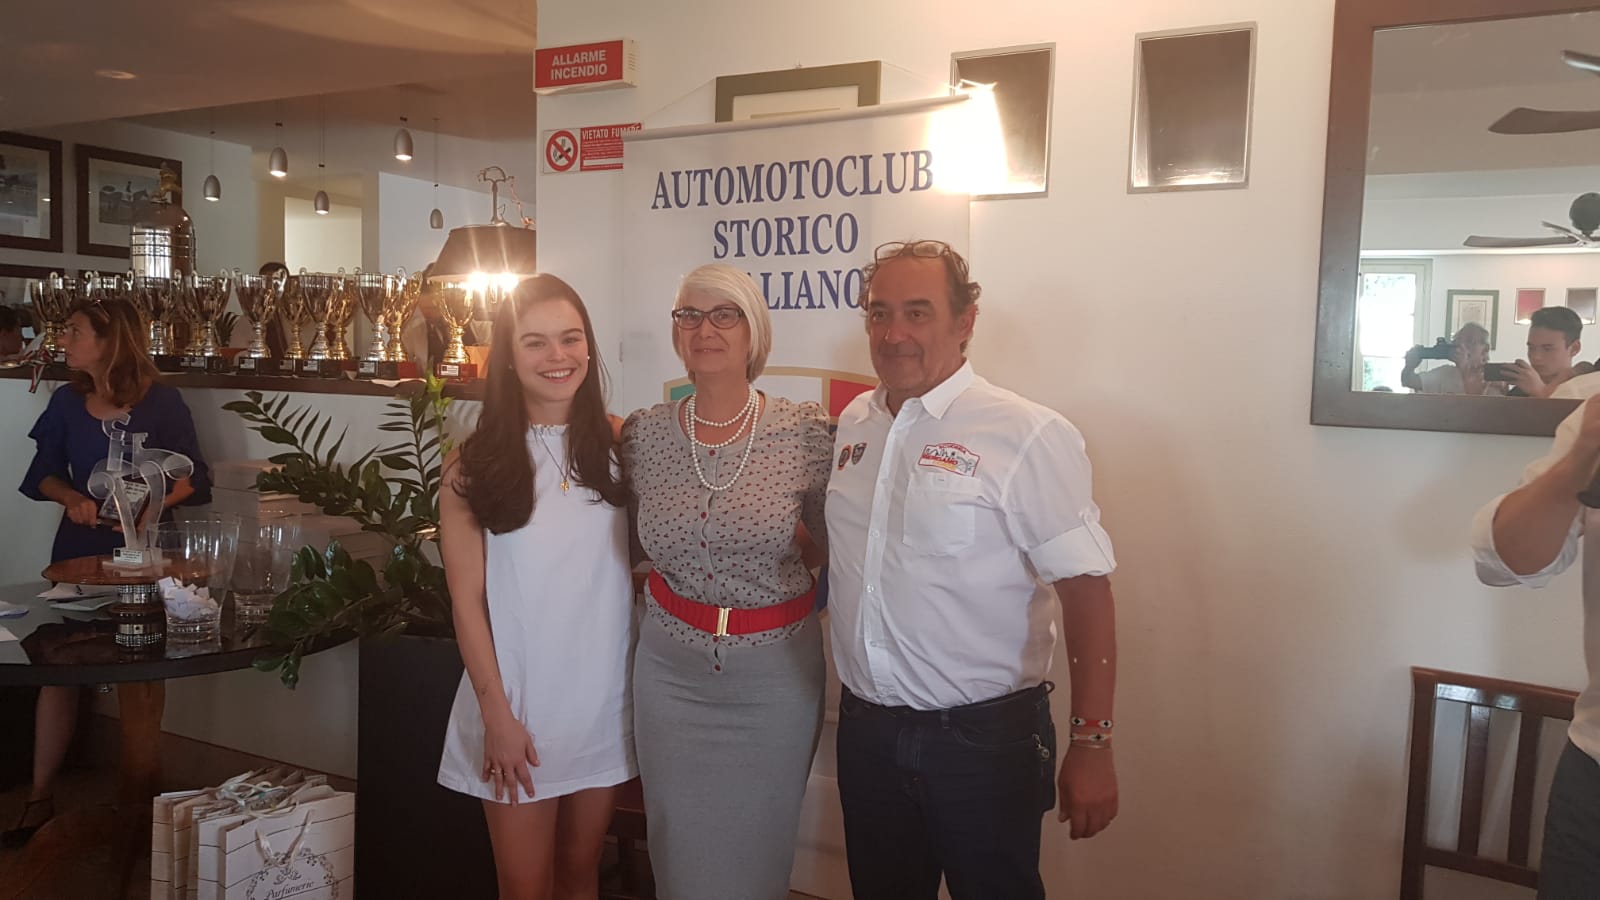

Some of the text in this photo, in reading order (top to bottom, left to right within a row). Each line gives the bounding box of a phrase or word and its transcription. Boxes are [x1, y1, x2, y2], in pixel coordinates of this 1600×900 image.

[551, 63, 607, 80] INCENDIO
[552, 50, 606, 66] ALLARME
[582, 129, 608, 139] VIETATO
[651, 149, 933, 209] AUTOMOTOCLUB
[713, 212, 859, 259] STORICO
[748, 268, 865, 310] LIANO
